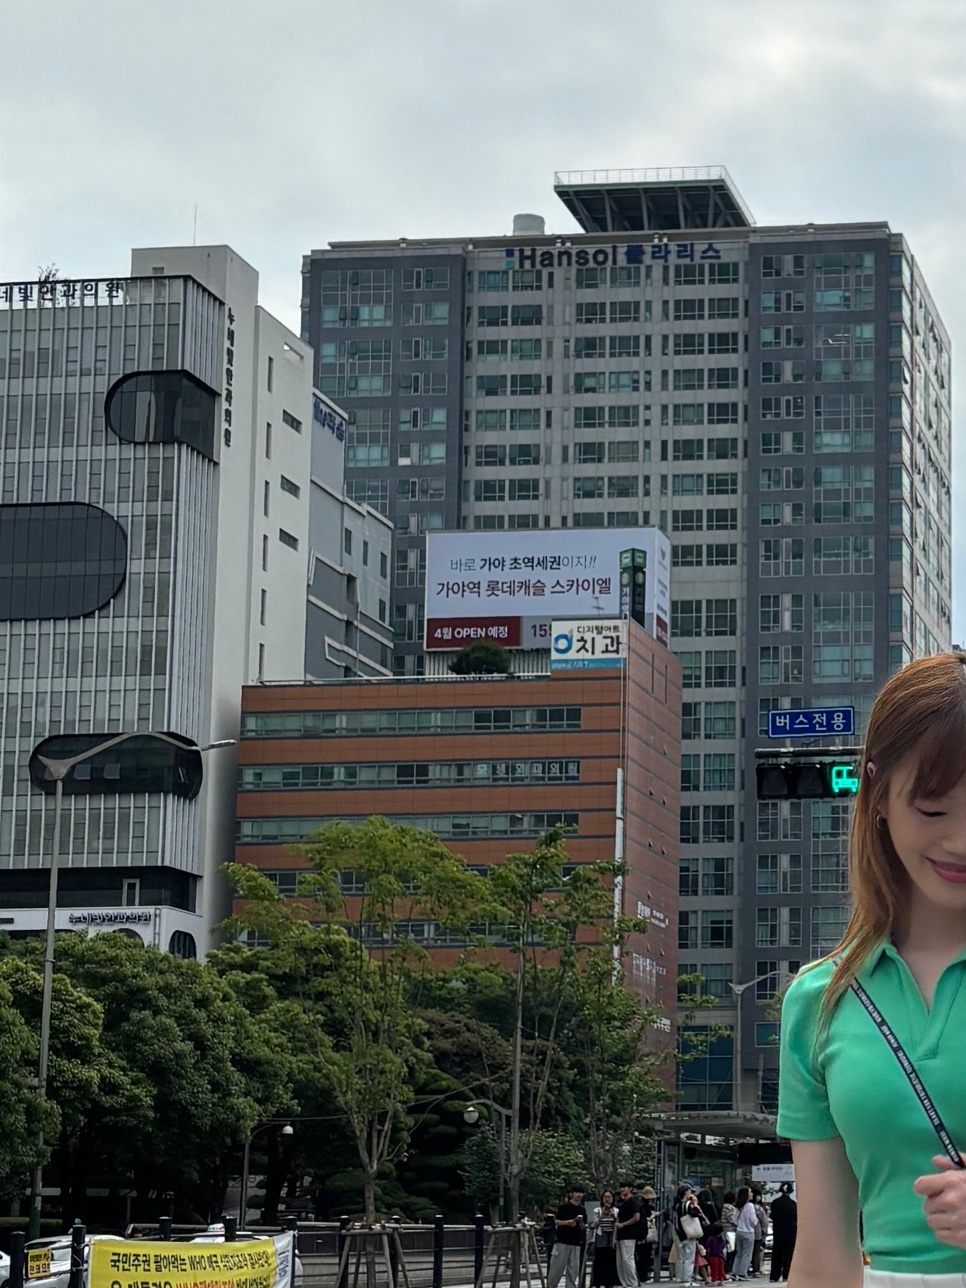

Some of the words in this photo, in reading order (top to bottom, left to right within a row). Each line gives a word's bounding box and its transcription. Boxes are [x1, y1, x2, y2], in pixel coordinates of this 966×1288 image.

[518, 245, 617, 269] Hansol
[450, 557, 476, 573] 바로
[479, 557, 506, 572] 가야
[436, 580, 481, 599] 가야역
[485, 578, 546, 598] 롯데캐슬
[550, 576, 611, 595] 스카이엘
[434, 626, 452, 640] 4월
[454, 626, 485, 640] OPEN
[487, 625, 508, 639] 예정
[531, 623, 552, 638] 15
[576, 635, 623, 656] 치과
[776, 712, 847, 731] 버스전용
[110, 1252, 151, 1273] 국민주권
[153, 1254, 187, 1273] 팔아먹는
[189, 1253, 207, 1272] WHO
